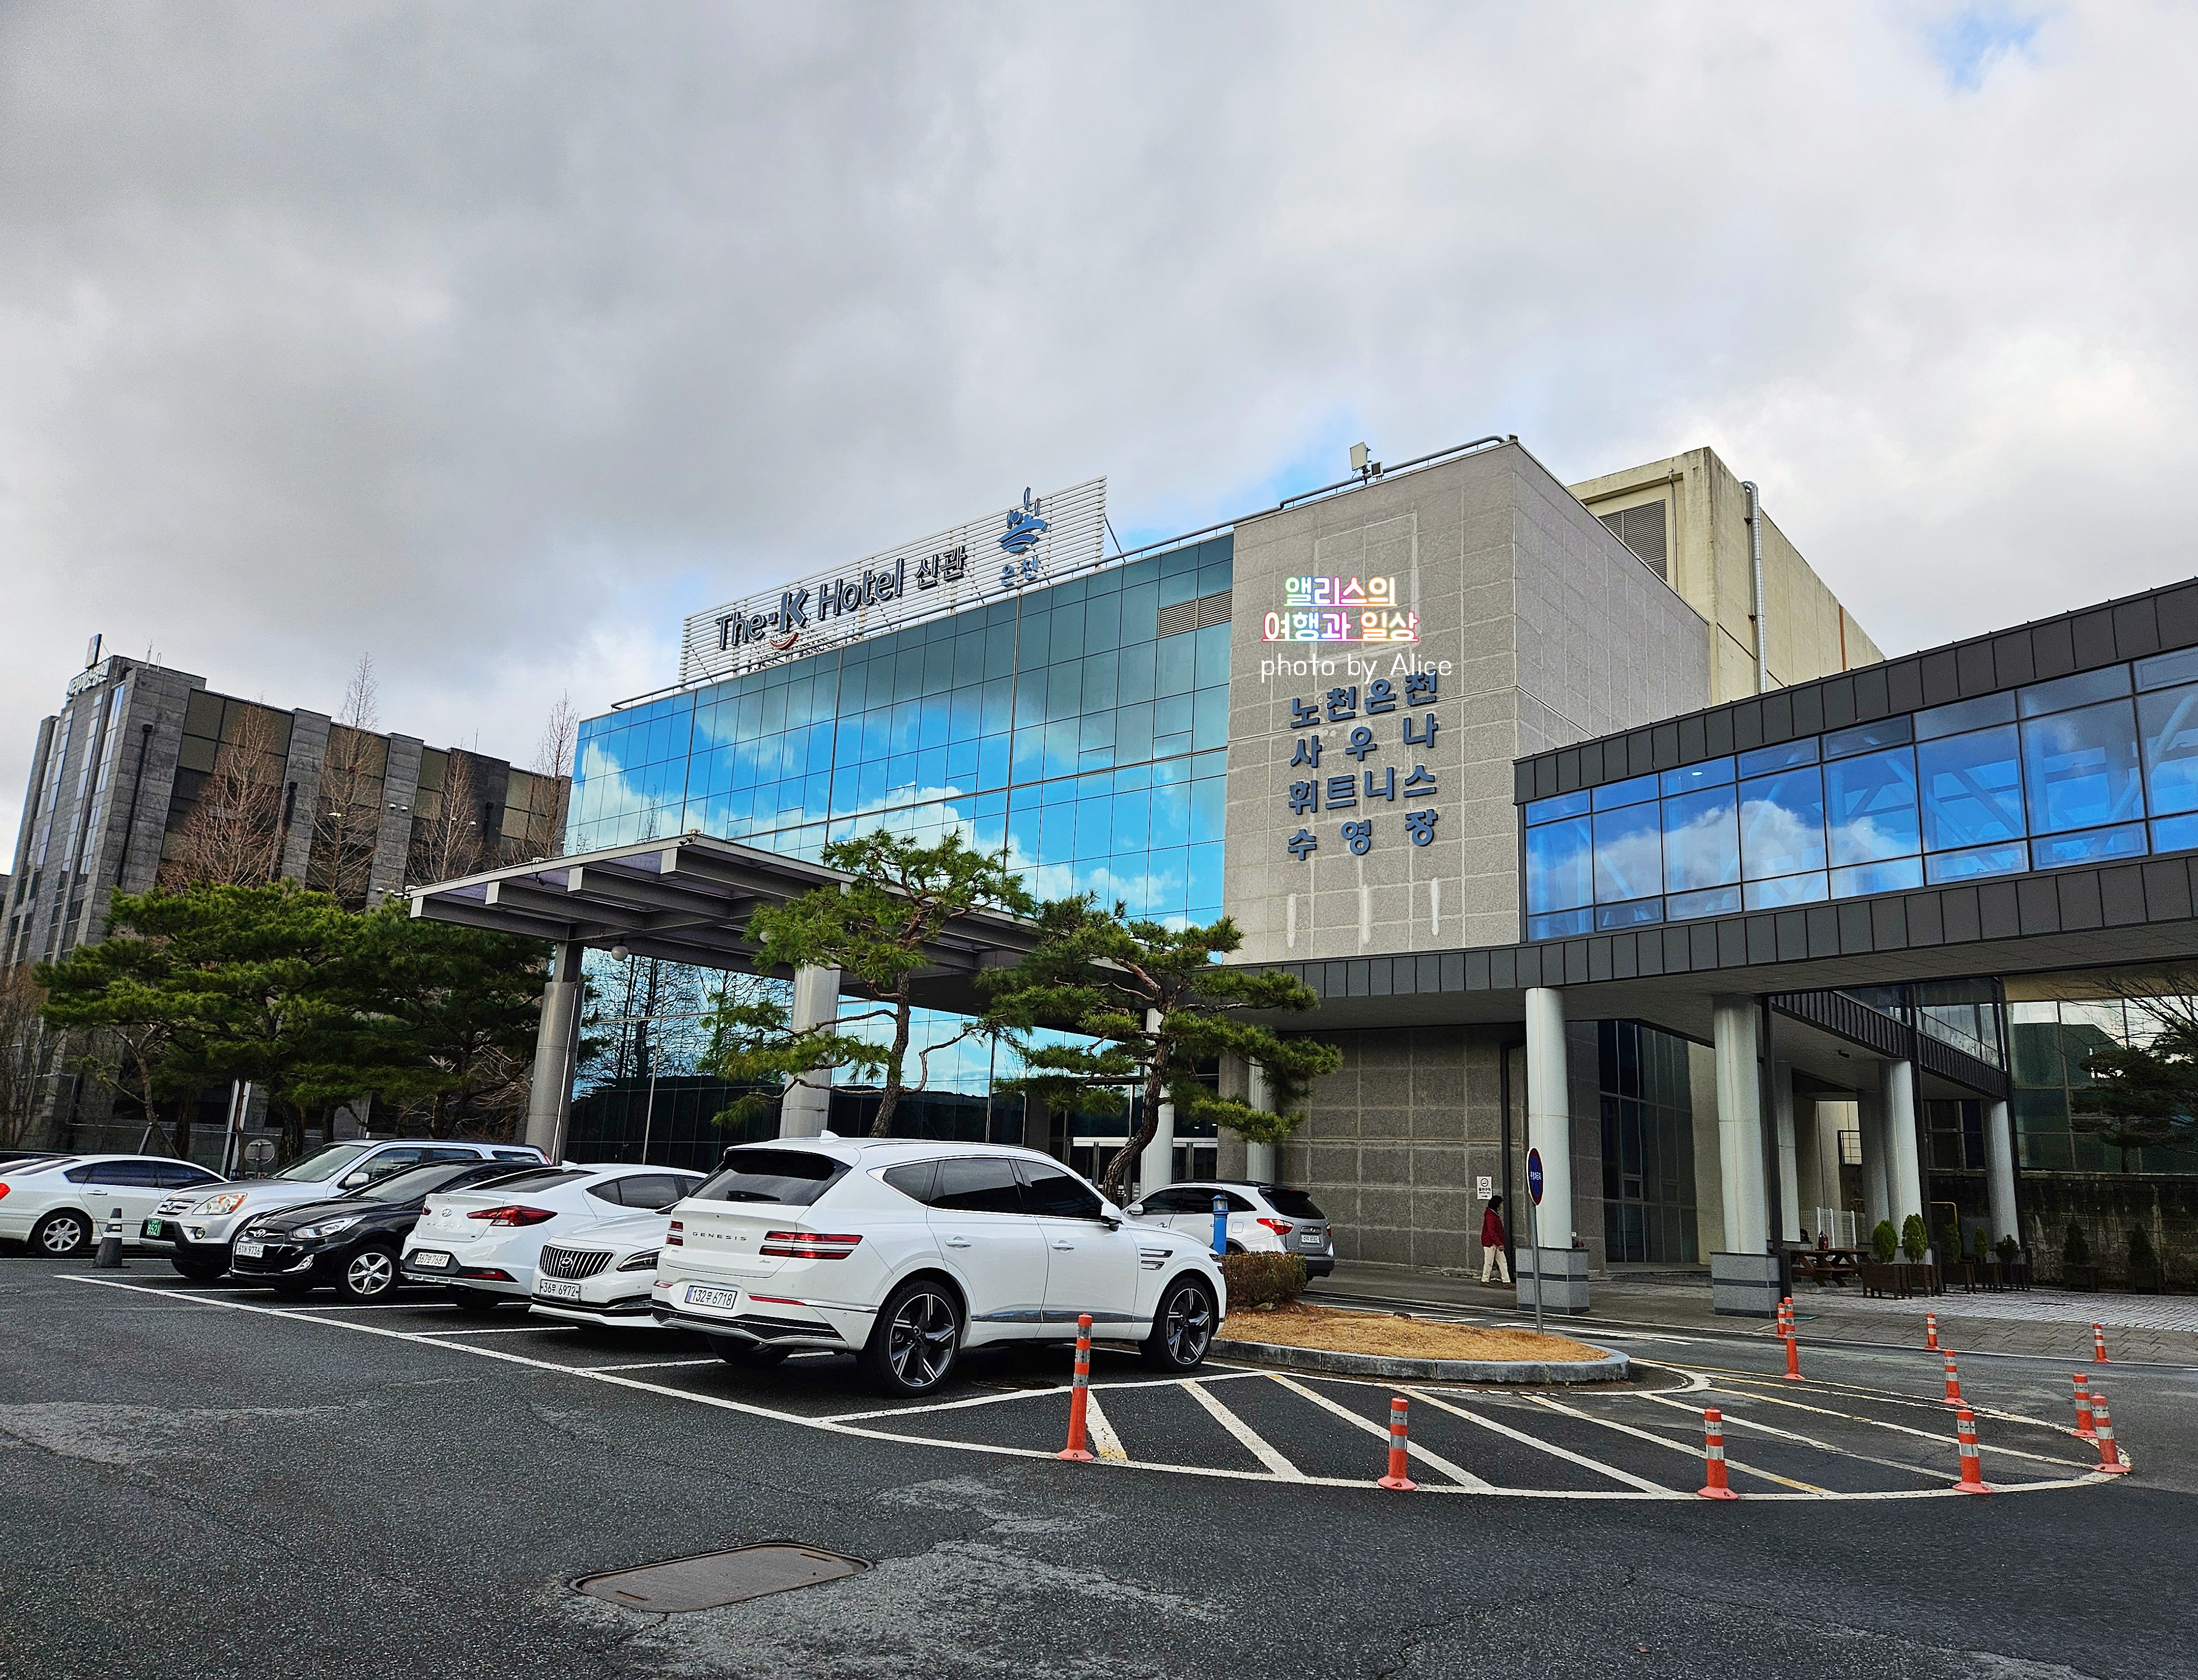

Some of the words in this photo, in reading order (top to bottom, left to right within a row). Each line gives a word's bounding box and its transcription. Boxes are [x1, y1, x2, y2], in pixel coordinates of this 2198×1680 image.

[818, 558, 905, 621] Hotel
[915, 544, 967, 589] 신관
[1290, 669, 1438, 729] 노천온천
[1291, 713, 1438, 768] 사우나
[1288, 765, 1437, 815] 휘트니스
[1288, 808, 1438, 860] 수영장
[147, 1224, 160, 1235] 8521
[248, 1246, 260, 1255] 9736
[692, 1231, 747, 1241] GENESIS
[558, 1284, 576, 1297] 6972
